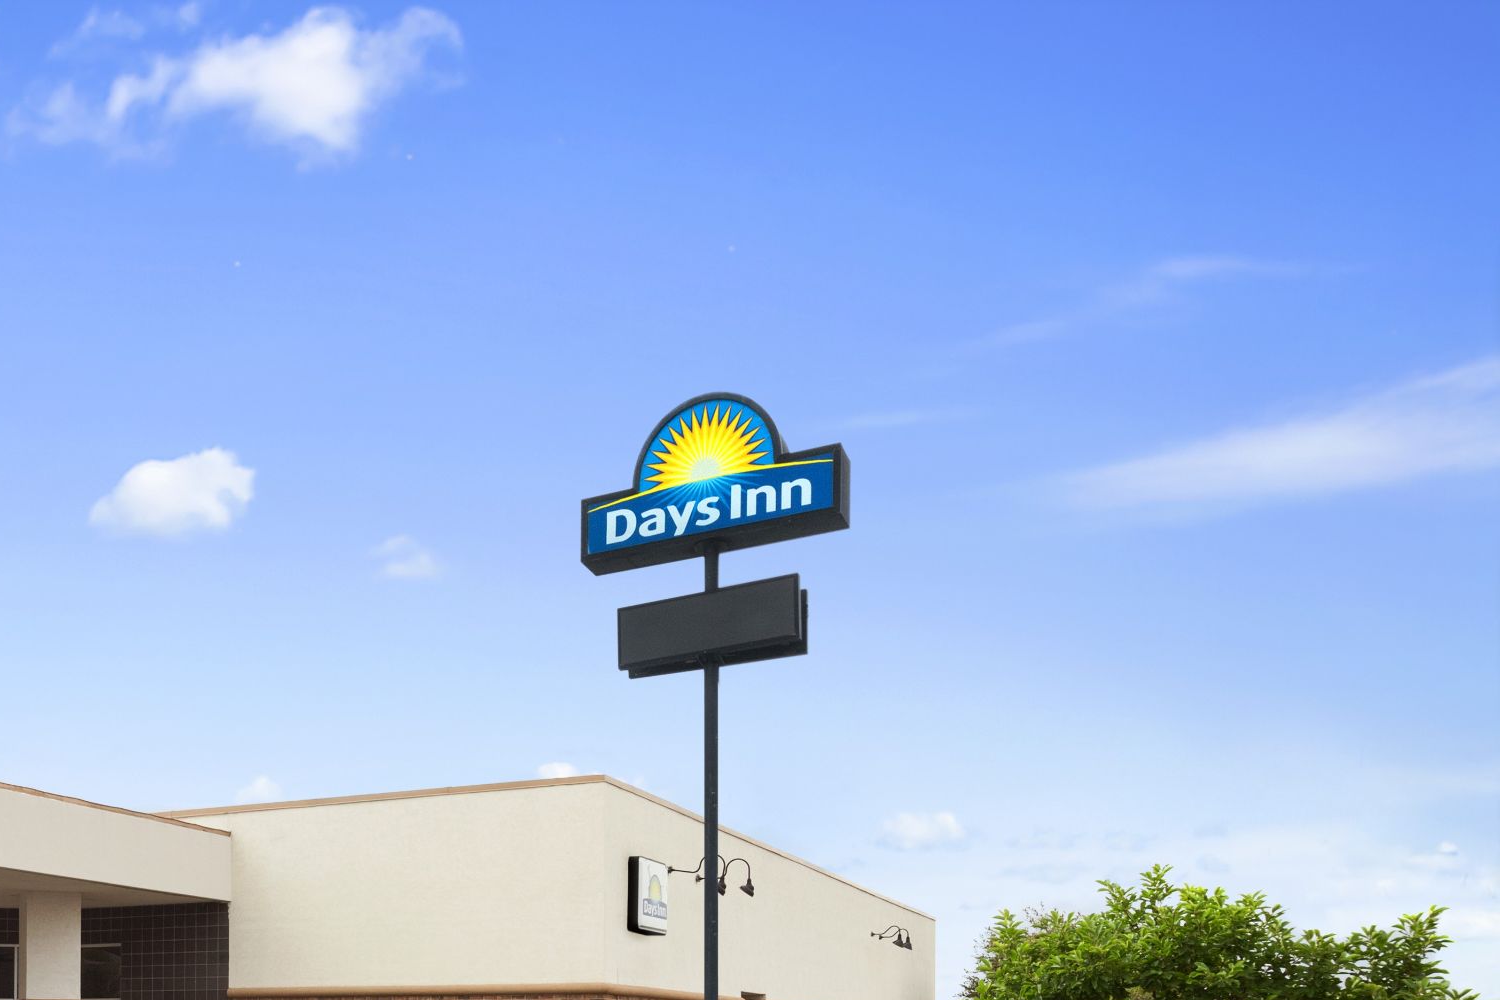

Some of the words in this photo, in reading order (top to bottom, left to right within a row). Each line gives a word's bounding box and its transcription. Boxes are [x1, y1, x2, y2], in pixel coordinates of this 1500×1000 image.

[606, 496, 720, 545] Days
[730, 478, 812, 520] Inn
[644, 900, 658, 916] Days
